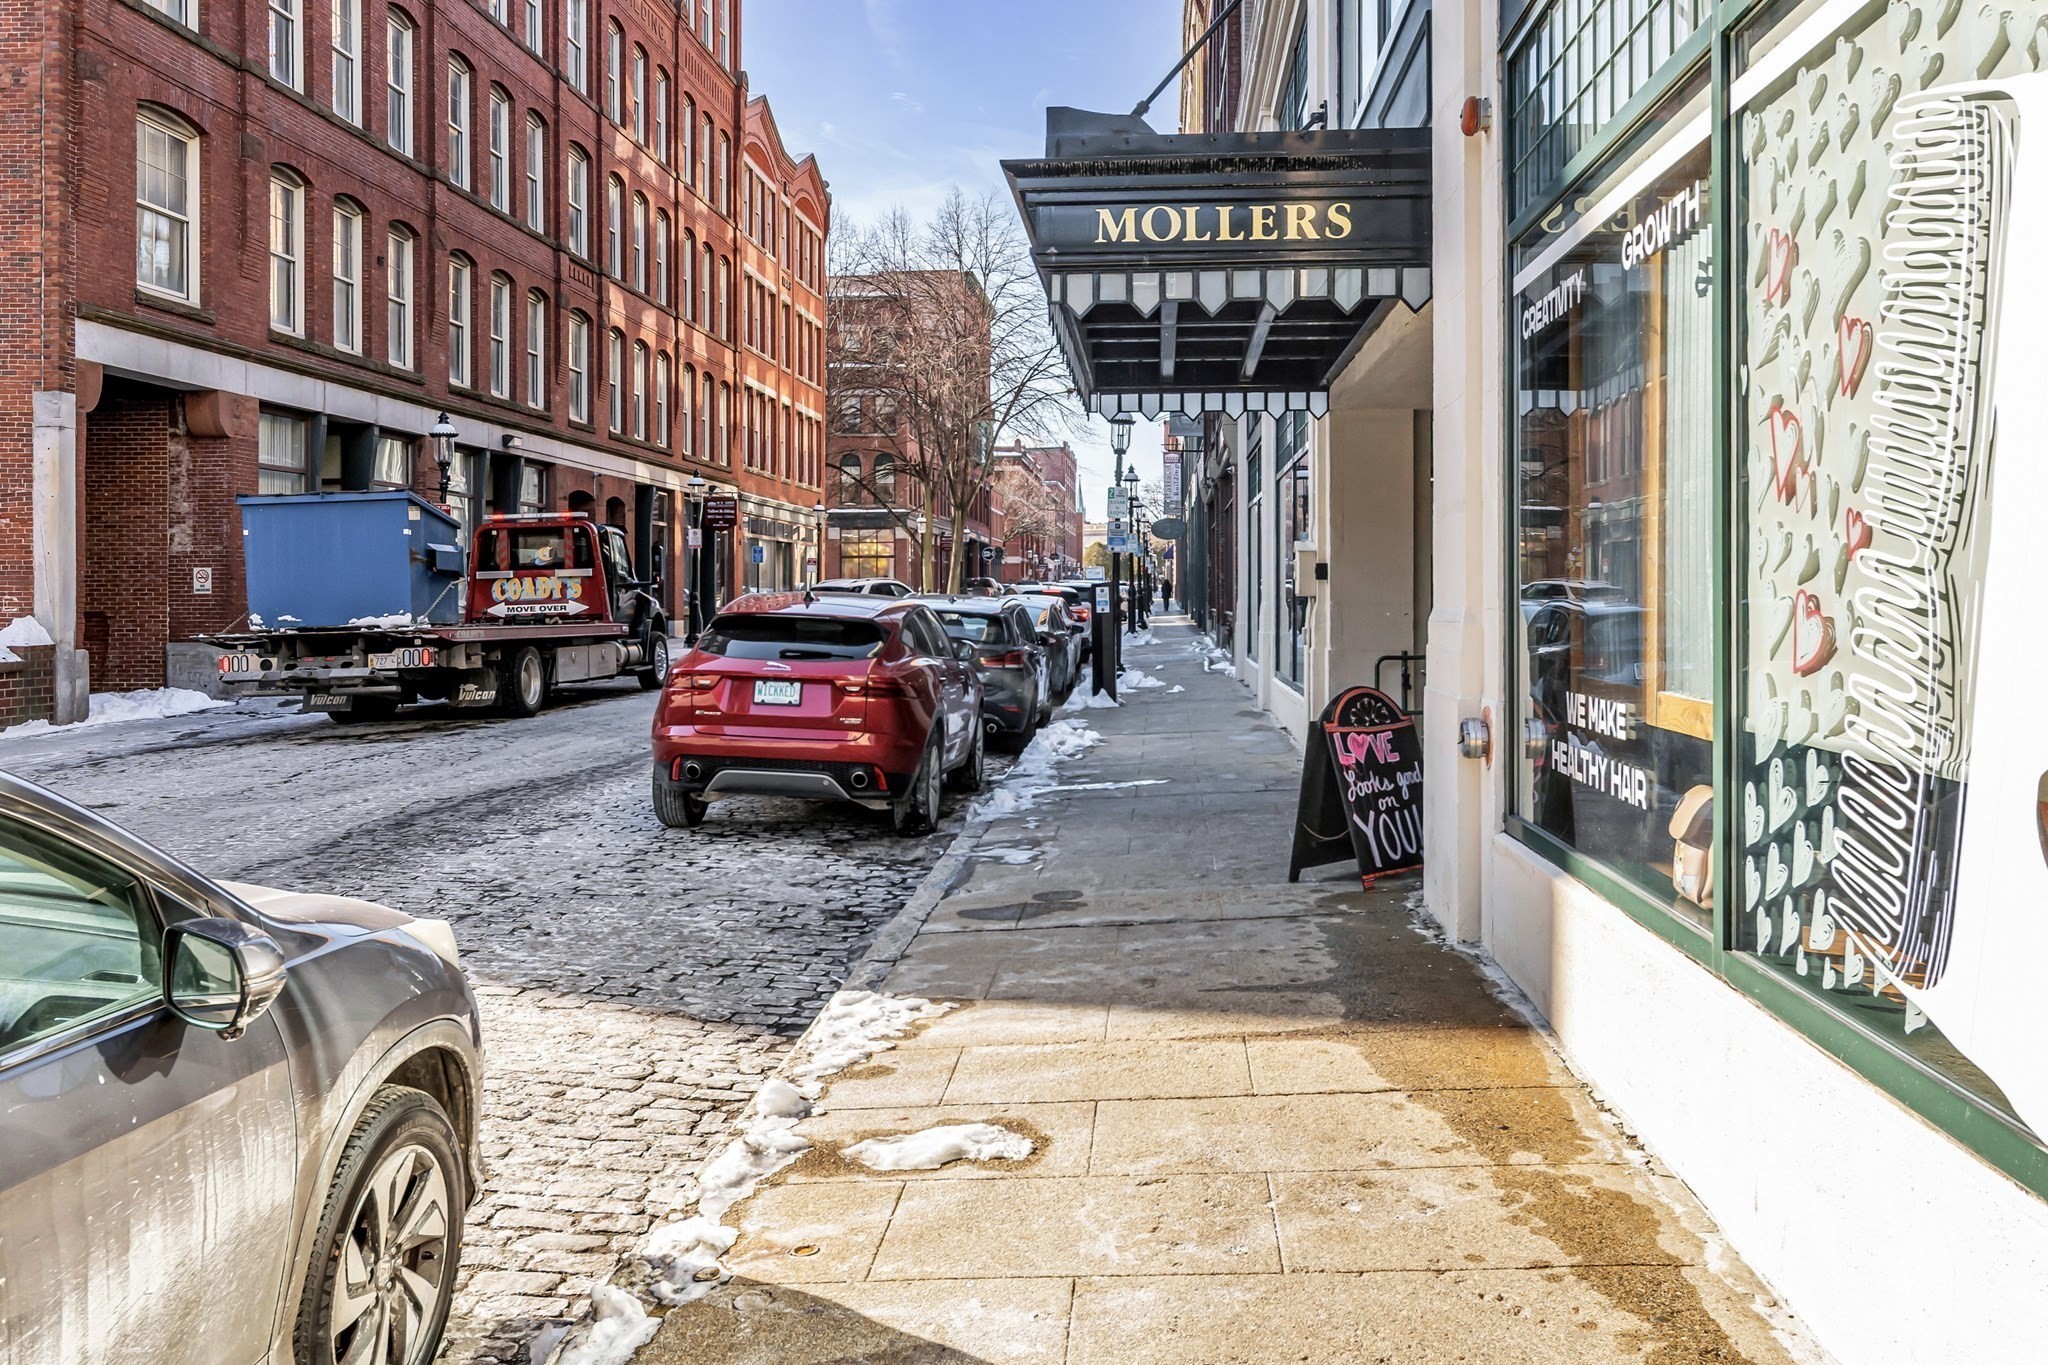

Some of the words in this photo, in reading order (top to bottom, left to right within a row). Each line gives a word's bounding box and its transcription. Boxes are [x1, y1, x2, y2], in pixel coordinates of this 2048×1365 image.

[1095, 203, 1352, 243] MOLLERS
[1621, 179, 1700, 271] GROWTH
[1522, 268, 1584, 340] CREATIVITY
[491, 576, 582, 602] COADY'S
[506, 605, 536, 613] MOVE
[539, 604, 567, 612] OVER
[310, 693, 348, 705] Vulcan
[458, 686, 497, 701] Vulcan
[757, 684, 796, 698] WICKKED
[1565, 691, 1586, 728] WE
[1588, 695, 1627, 741] MAKE
[1396, 761, 1424, 800] good
[1551, 739, 1608, 793] HEALTHY
[1610, 760, 1647, 811] HAIR
[1378, 796, 1400, 811] on
